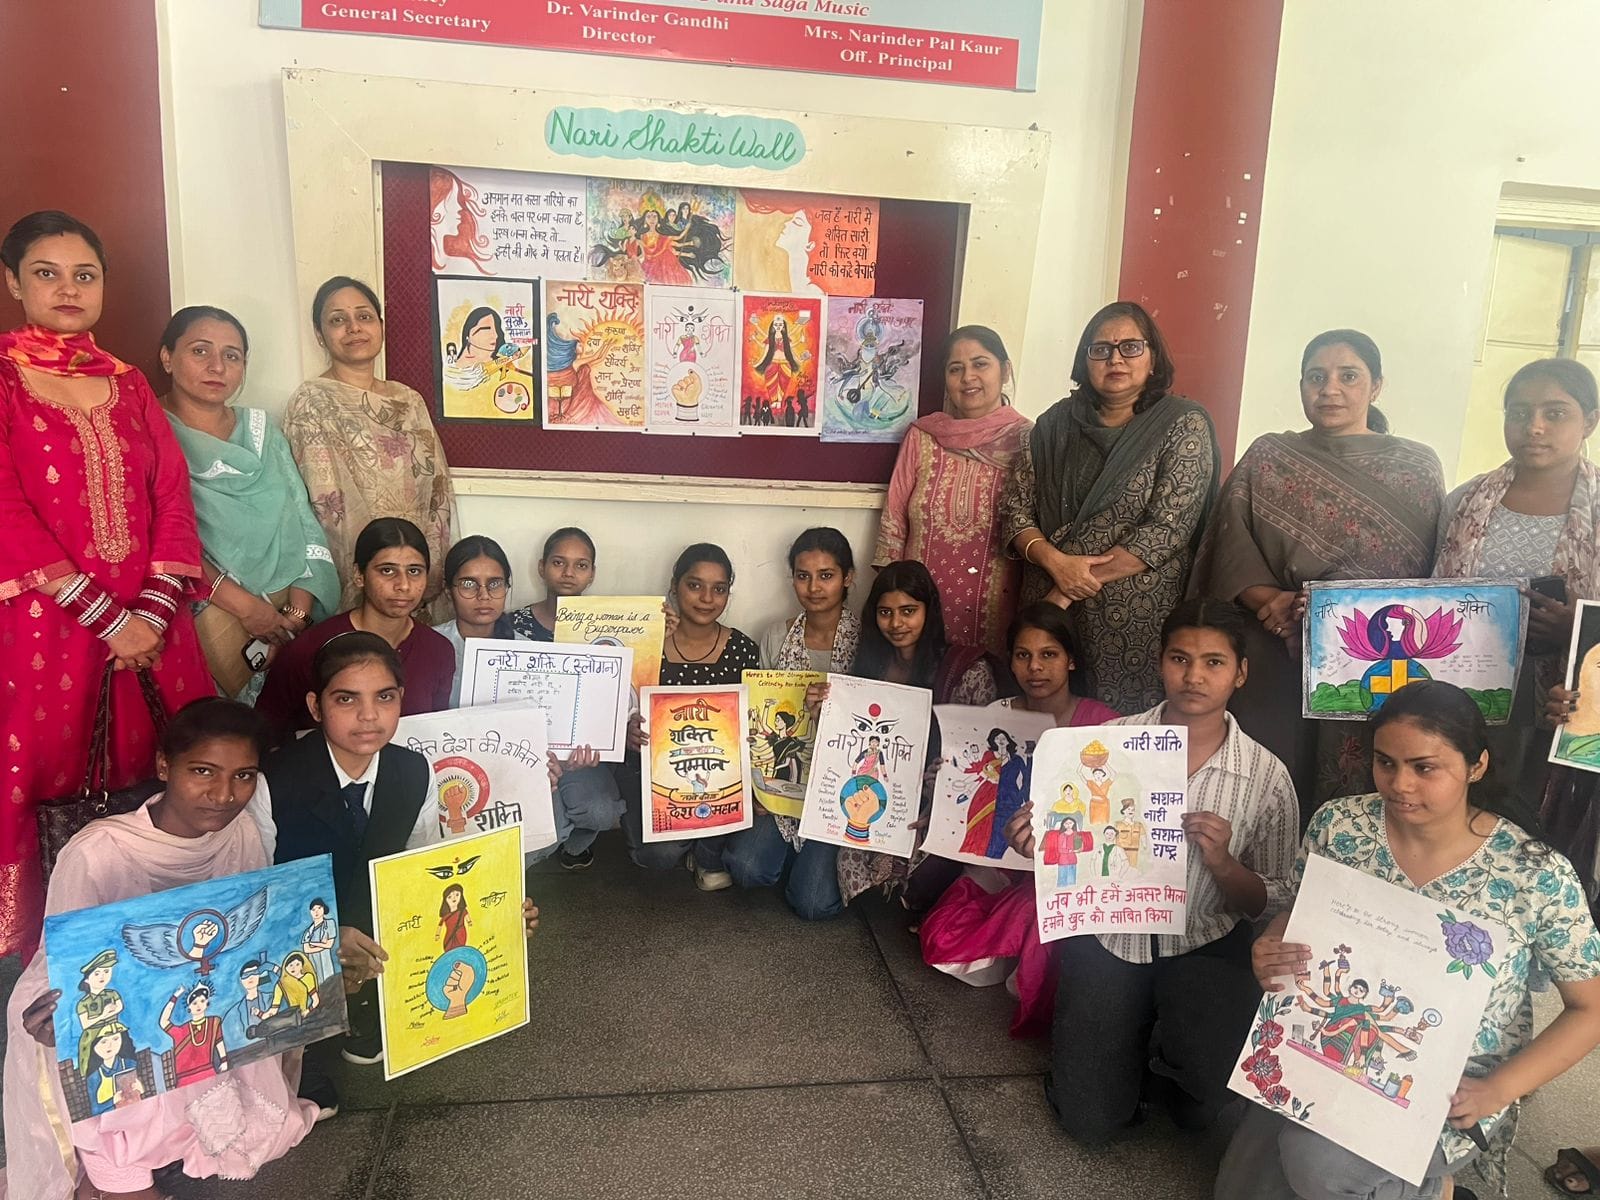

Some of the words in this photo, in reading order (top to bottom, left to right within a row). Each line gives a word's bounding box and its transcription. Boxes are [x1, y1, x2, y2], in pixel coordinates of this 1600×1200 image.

[321, 3, 398, 21] General
[402, 8, 492, 32] Secretary
[546, 1, 574, 16] Dr.
[581, 3, 660, 24] Varinder
[663, 12, 730, 30] Gandhi
[814, 0, 870, 17] Music
[582, 25, 657, 45] Director
[803, 24, 843, 41] Mrs.
[848, 28, 925, 48] Narinder
[928, 35, 956, 52] Pal
[959, 39, 1003, 56] Kaur
[840, 48, 873, 64] Off.
[878, 52, 953, 73] Principal
[549, 109, 619, 148] Nari
[622, 113, 726, 155] Shakti
[729, 126, 797, 163] Wall
[488, 650, 521, 667] नारी
[670, 697, 721, 722] नारी
[668, 724, 718, 746] शक्ति
[1122, 731, 1151, 751] नारी
[1143, 809, 1168, 823] नारी
